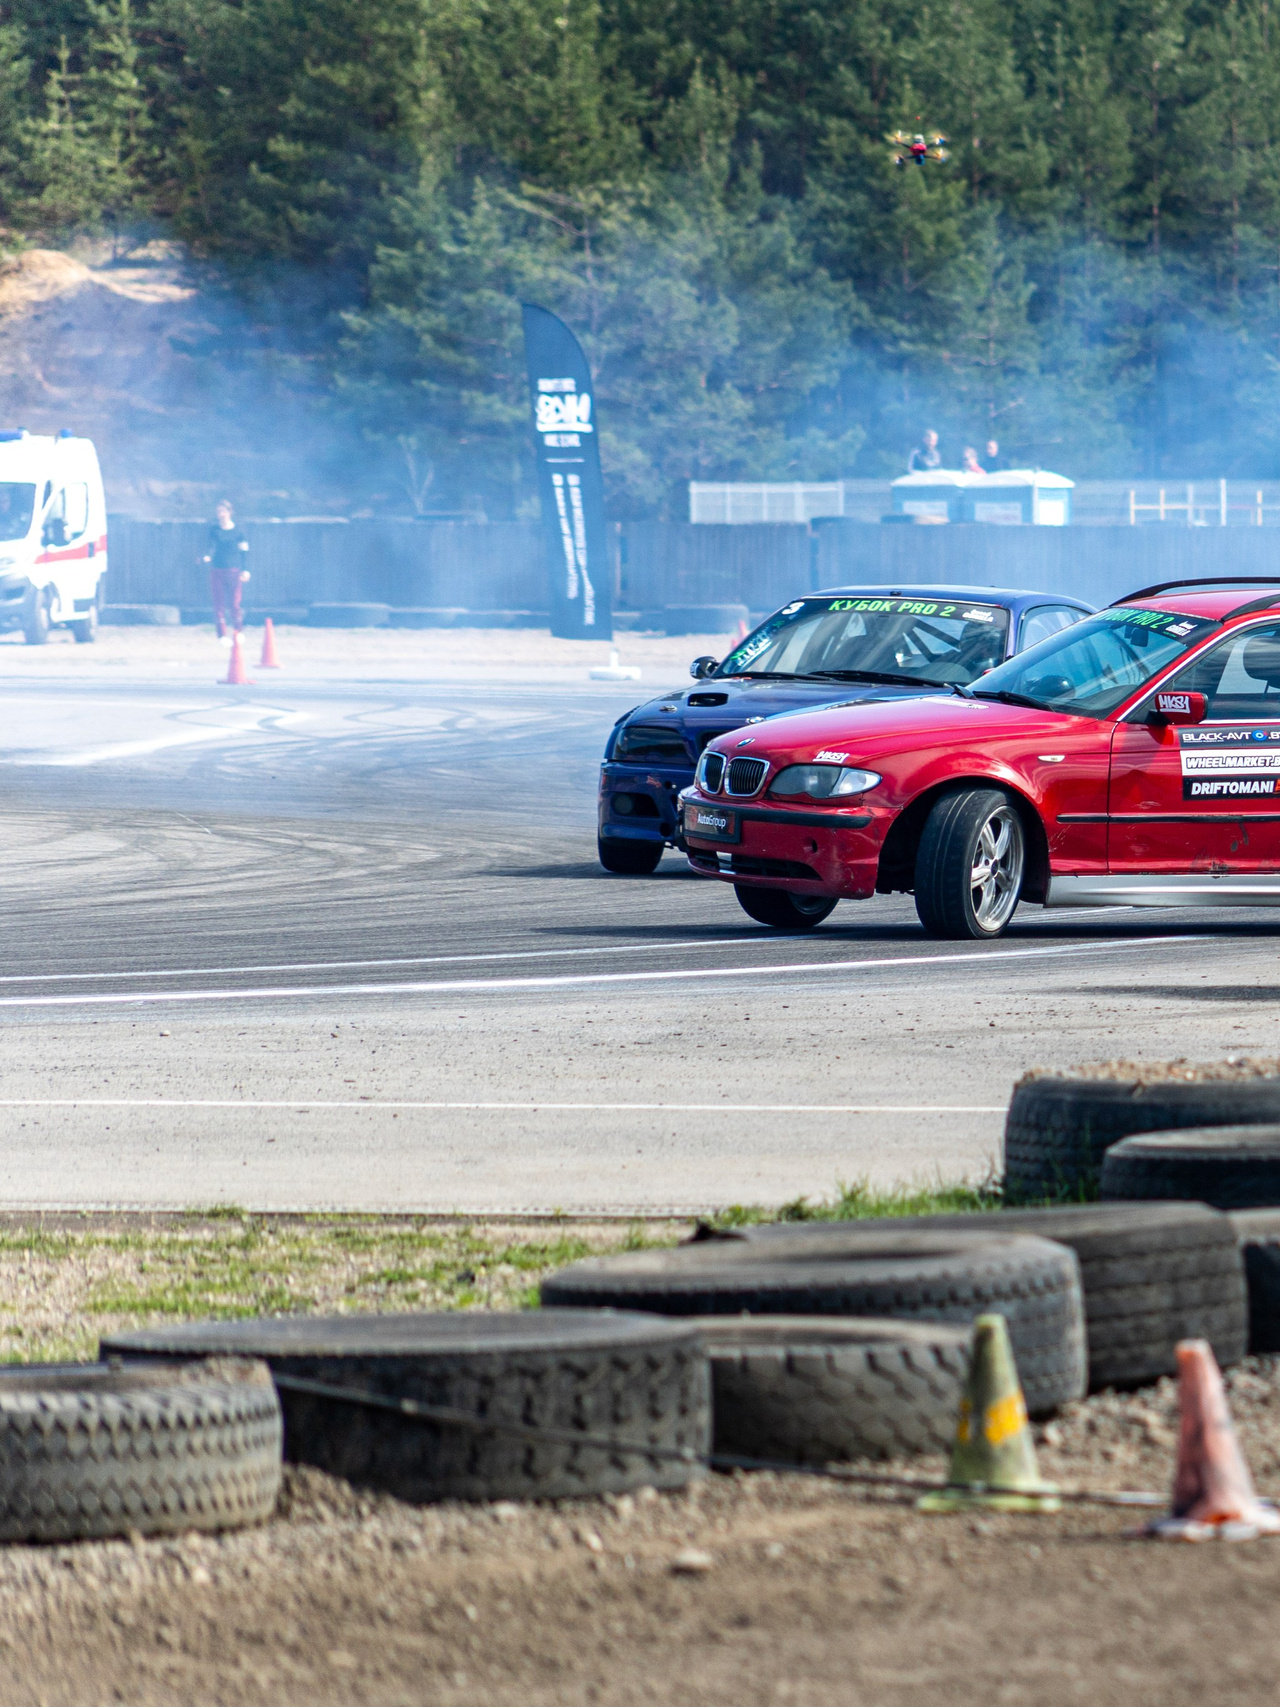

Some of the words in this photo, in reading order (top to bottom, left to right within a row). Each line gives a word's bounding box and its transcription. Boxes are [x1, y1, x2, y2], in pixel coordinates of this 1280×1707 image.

[782, 602, 805, 615] 3
[828, 600, 896, 612] КУБОК
[897, 602, 938, 615] PRO
[939, 605, 957, 617] 2
[1149, 616, 1175, 629] 2
[697, 813, 727, 829] AutoGroup
